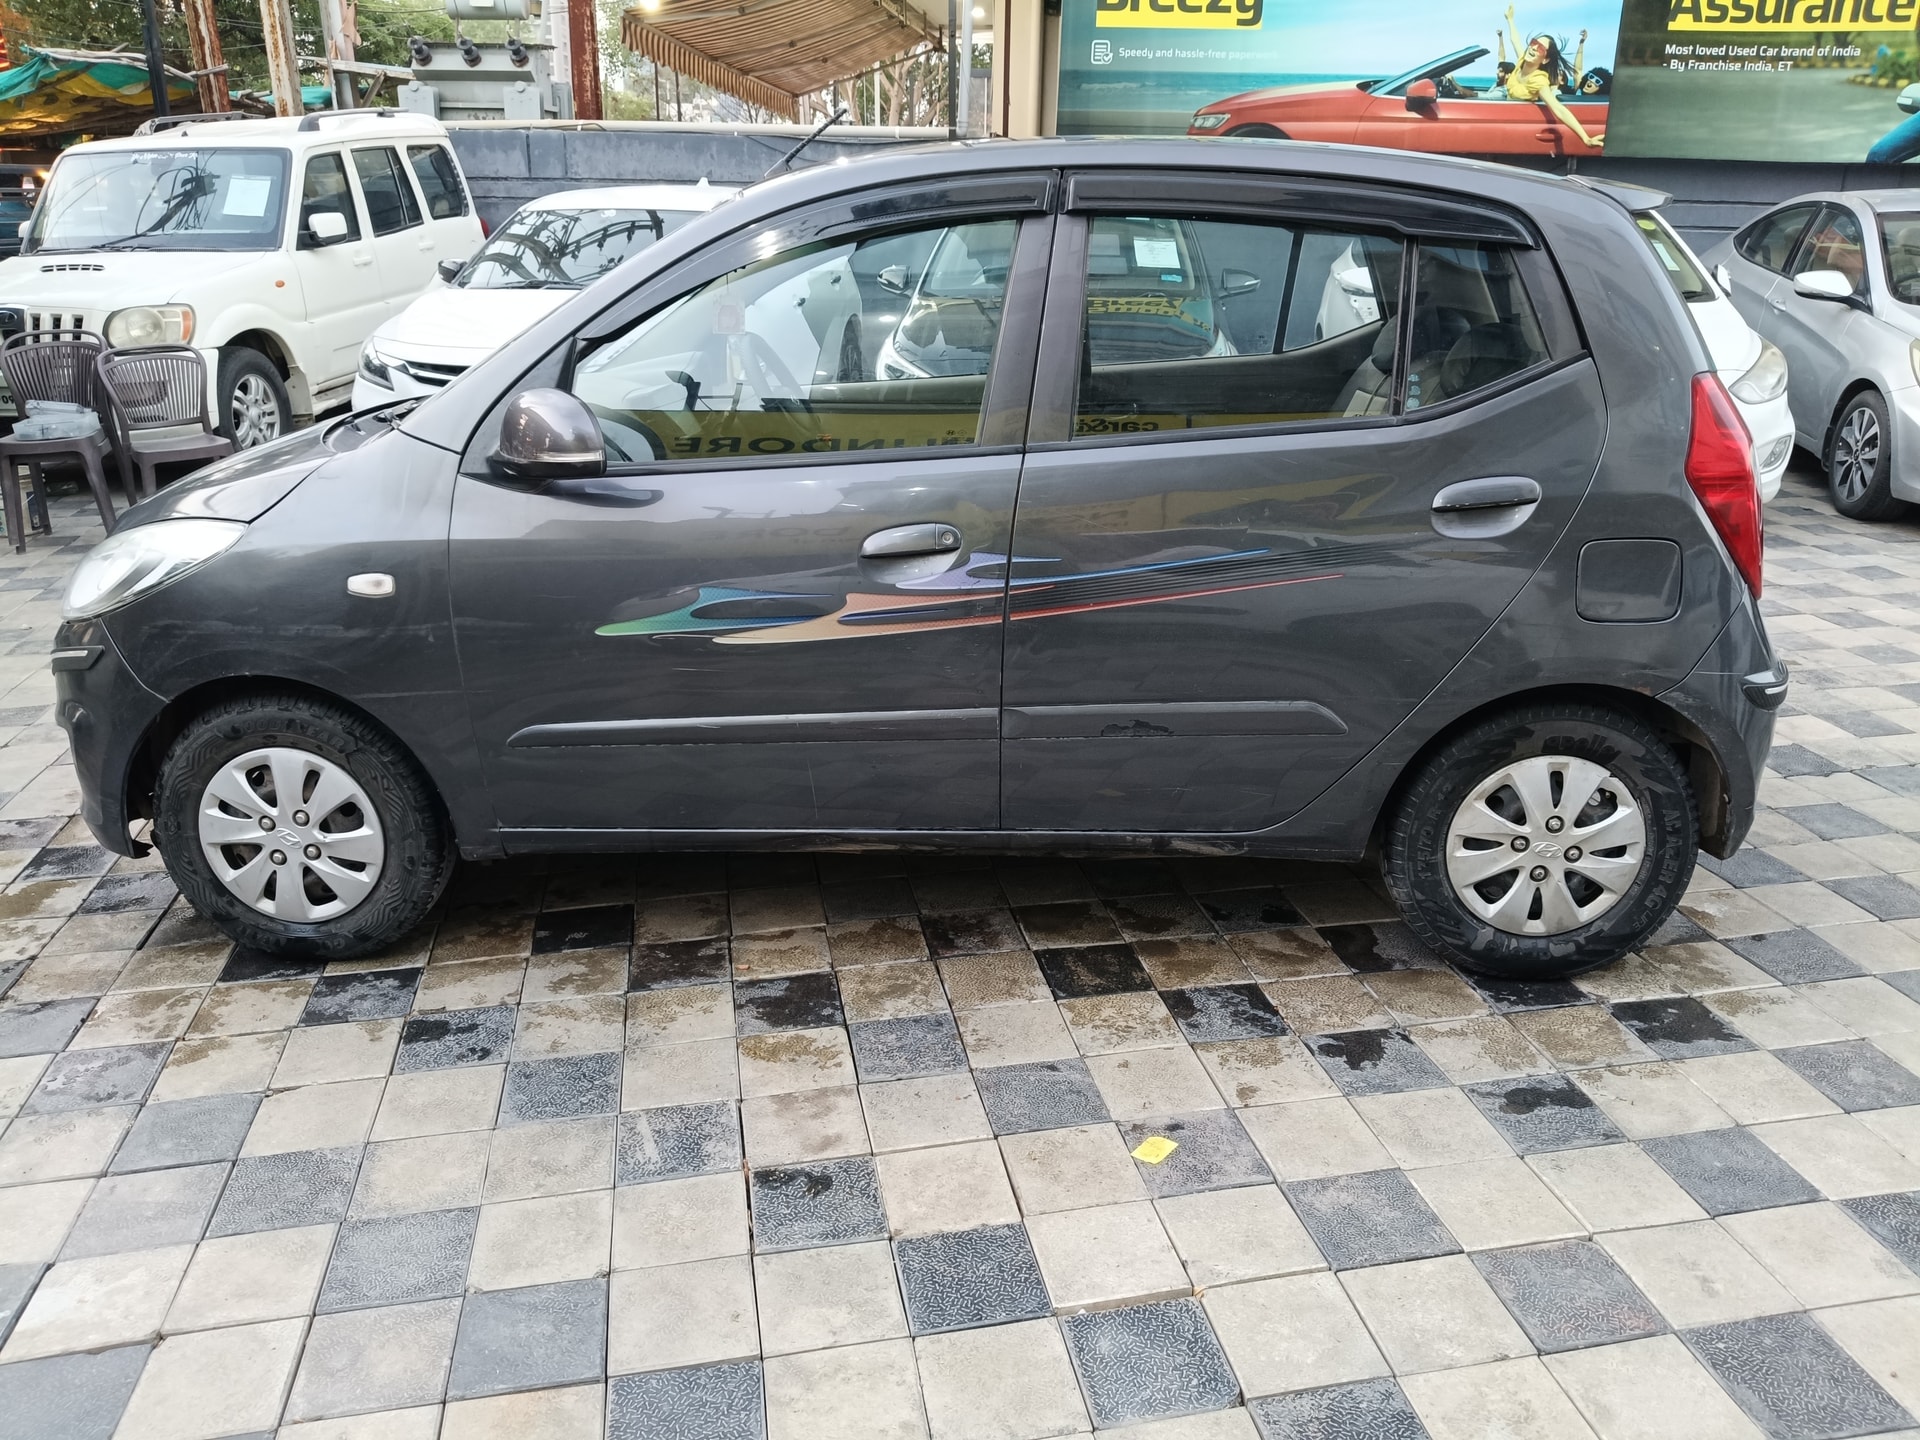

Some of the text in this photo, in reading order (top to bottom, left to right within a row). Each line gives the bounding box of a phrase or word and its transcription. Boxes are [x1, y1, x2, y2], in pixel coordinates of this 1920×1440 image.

[1667, 0, 1916, 23] Assurance
[1118, 47, 1278, 61] Speedy and hassle-free paperk
[1665, 44, 1861, 56] Most loved Used Car brand of India
[1670, 59, 1685, 72] By
[1688, 60, 1741, 71] Franchise
[1744, 61, 1775, 72] India,
[1778, 61, 1793, 71] ET
